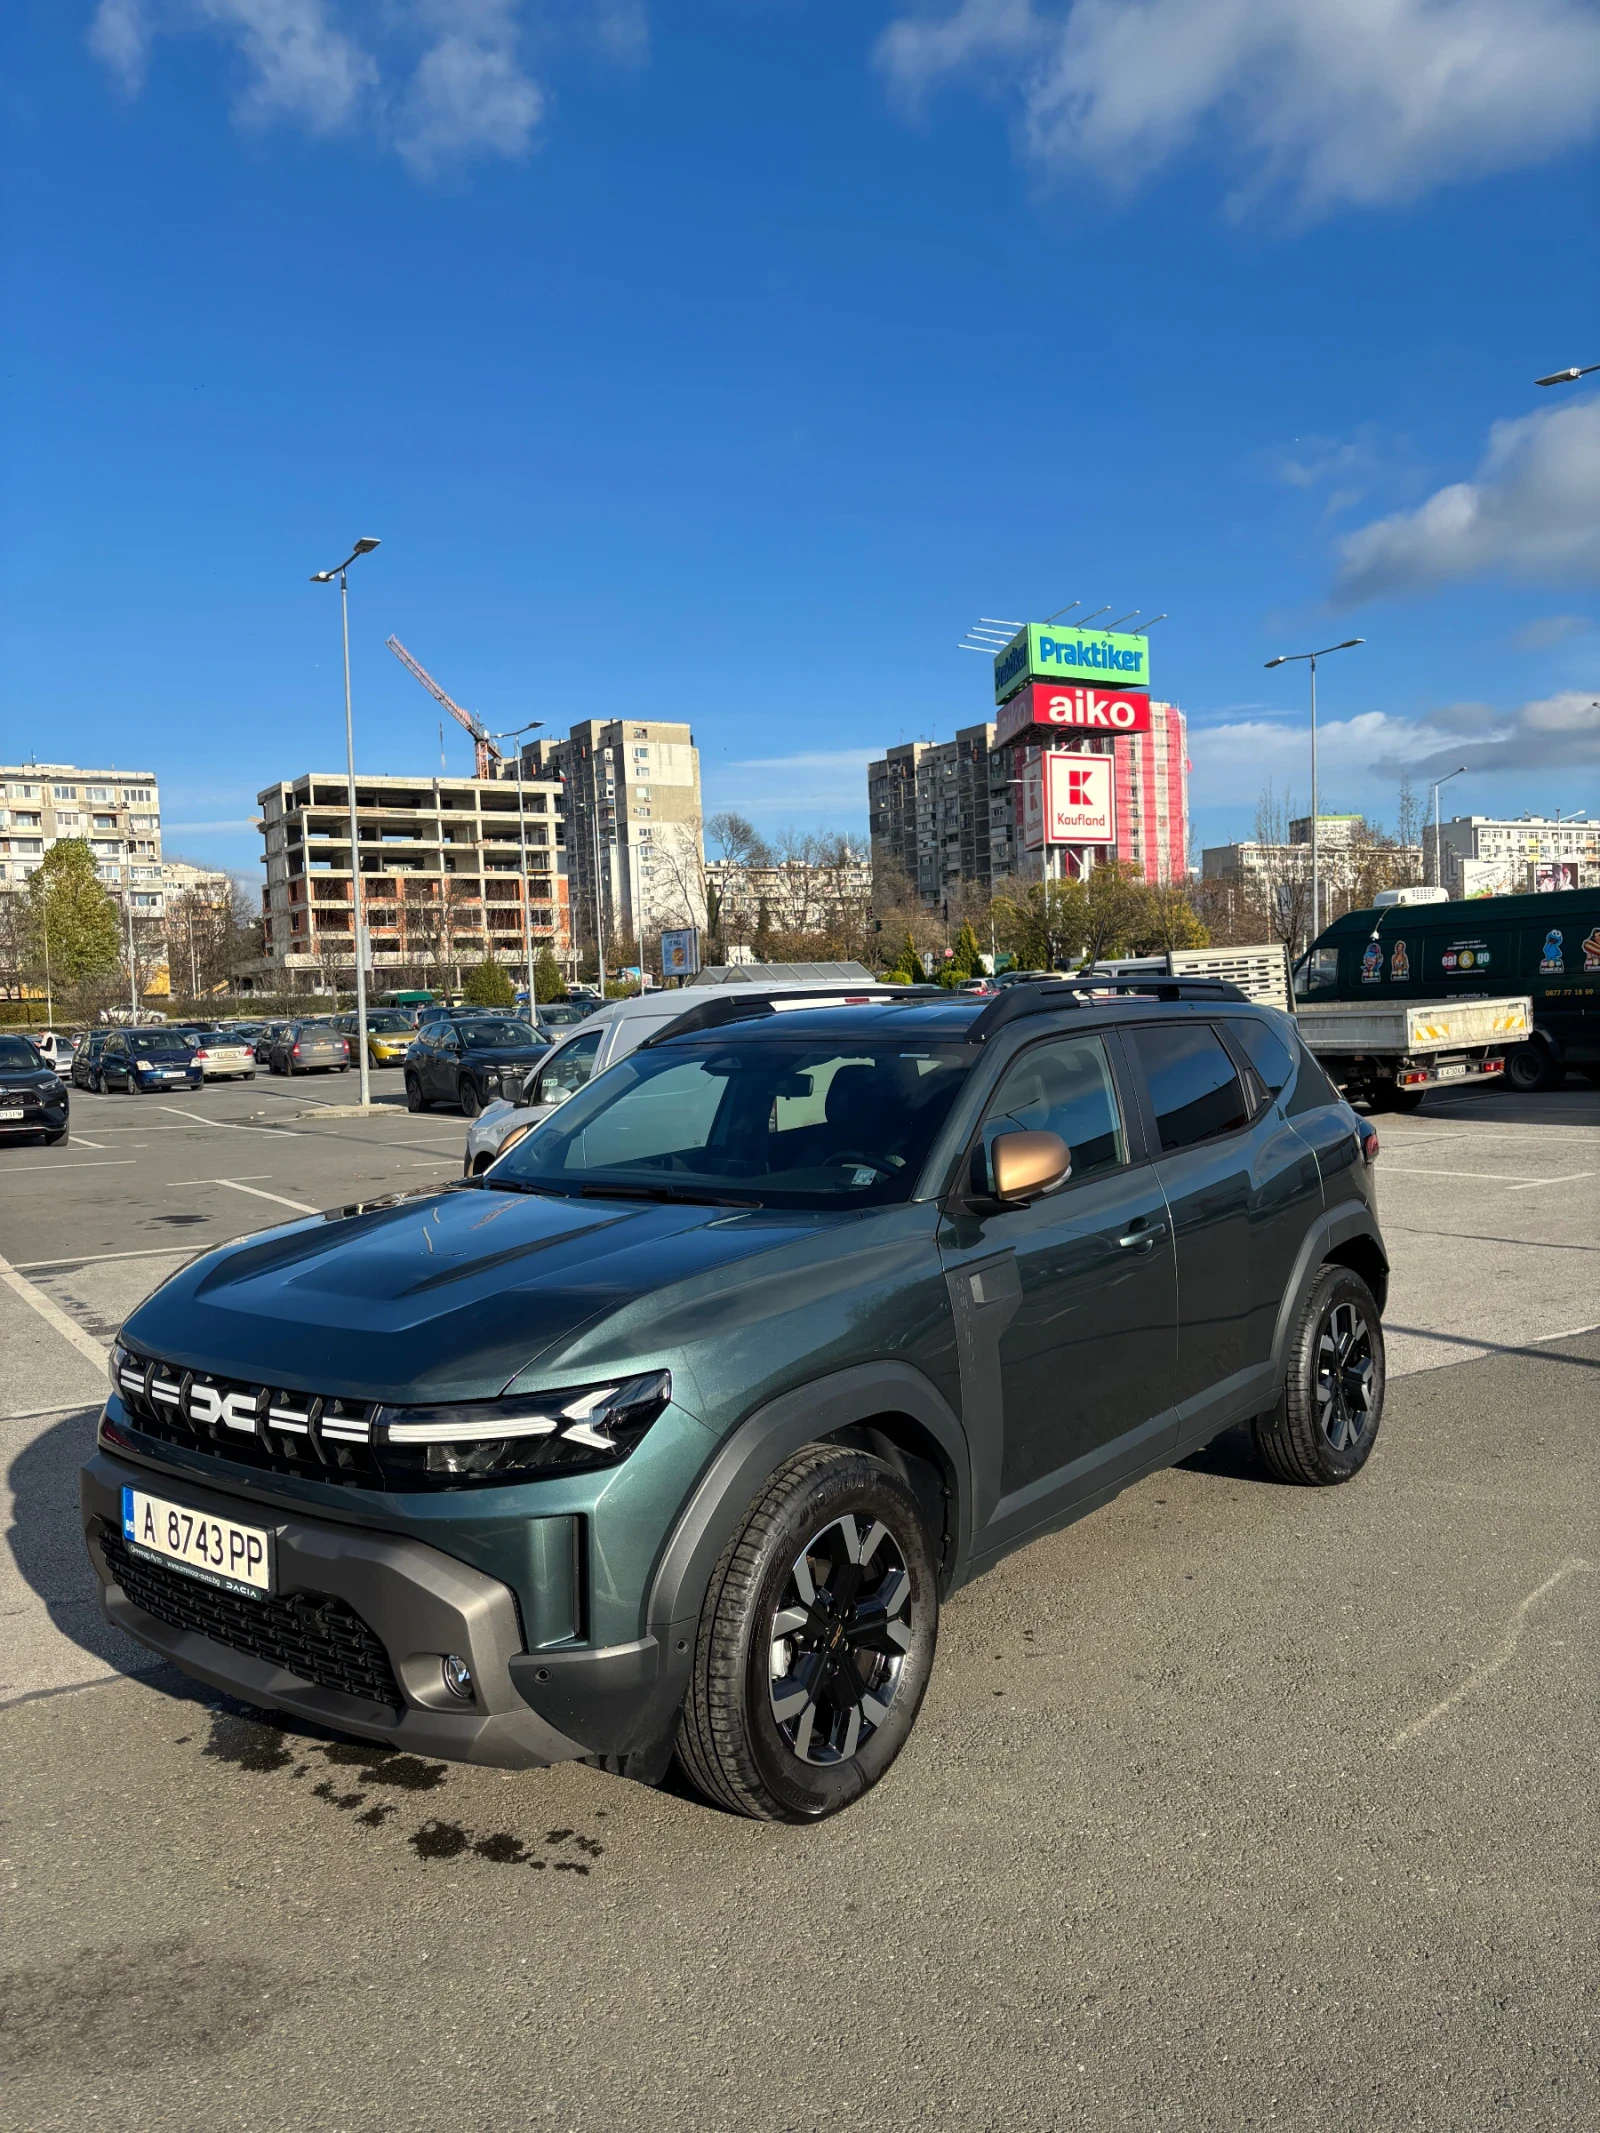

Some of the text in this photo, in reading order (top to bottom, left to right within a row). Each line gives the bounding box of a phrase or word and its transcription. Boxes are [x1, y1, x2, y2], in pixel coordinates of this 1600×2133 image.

[995, 642, 1027, 692] Praktiker
[1039, 635, 1143, 672] Praktiker
[1000, 701, 1026, 742] aiko
[1048, 689, 1135, 728] aiko
[1056, 812, 1105, 827] Kaufland
[1441, 954, 1457, 967] eat
[1476, 952, 1490, 964] go
[125, 1519, 135, 1533] BG
[225, 1581, 257, 1598] DACIA
